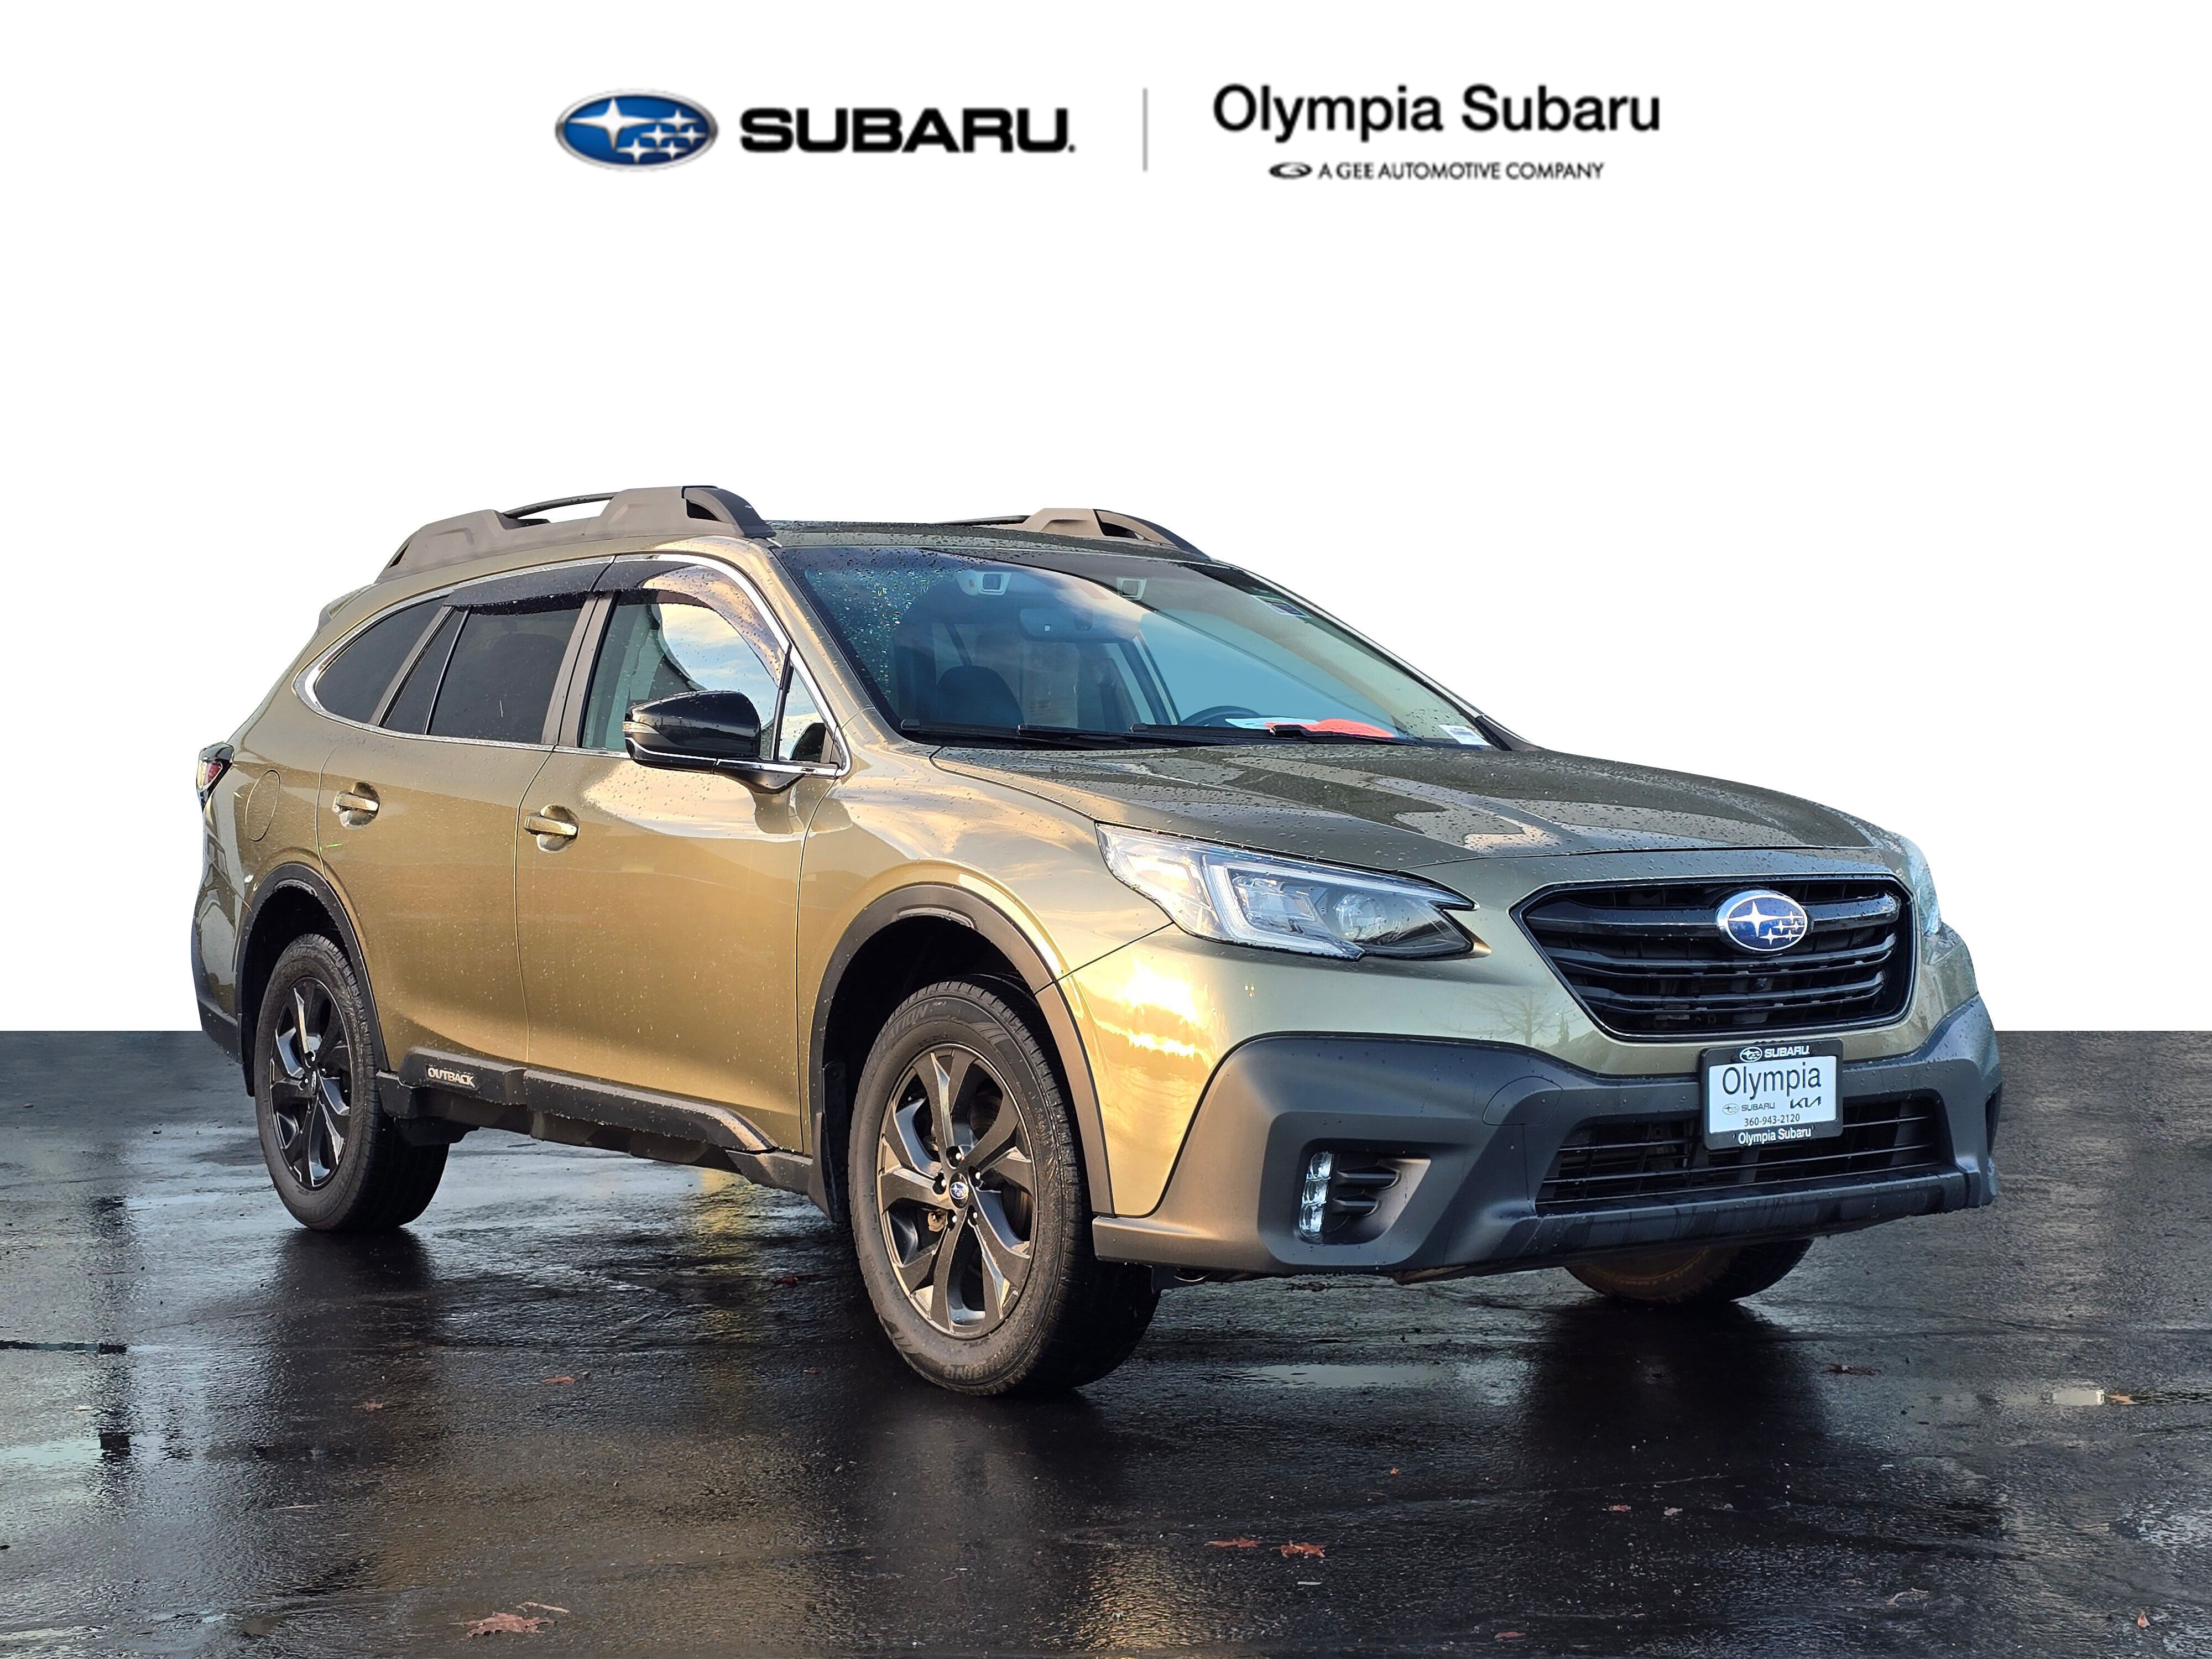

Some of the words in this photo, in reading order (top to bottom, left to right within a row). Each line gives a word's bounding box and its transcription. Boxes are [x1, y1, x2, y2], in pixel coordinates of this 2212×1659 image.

[427, 1067, 476, 1088] OUTBACK
[1722, 1062, 1822, 1100] Olympia
[1741, 1102, 1776, 1112] SUBARU
[1744, 1113, 1801, 1127] 360-943-2120
[1738, 1129, 1776, 1146] Olympia
[1778, 1127, 1812, 1140] Subaru
